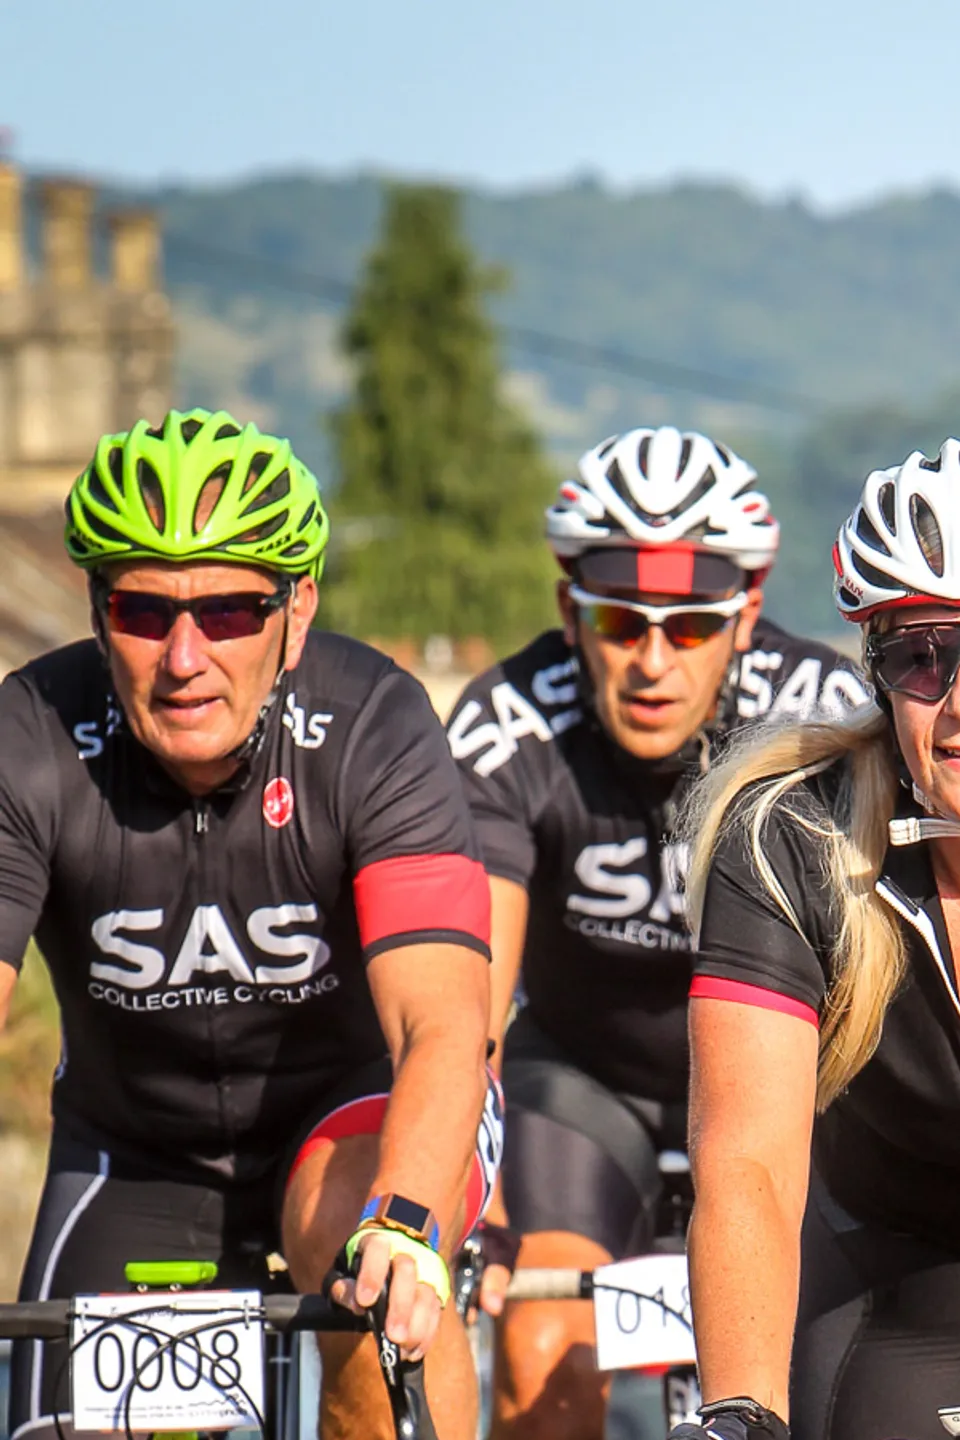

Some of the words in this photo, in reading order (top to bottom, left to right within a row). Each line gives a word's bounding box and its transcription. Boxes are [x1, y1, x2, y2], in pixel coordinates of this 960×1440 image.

[566, 837, 694, 922] SA
[90, 903, 331, 990] SAS
[88, 982, 228, 1011] COLLECTIVE
[94, 1330, 242, 1392] 0008
